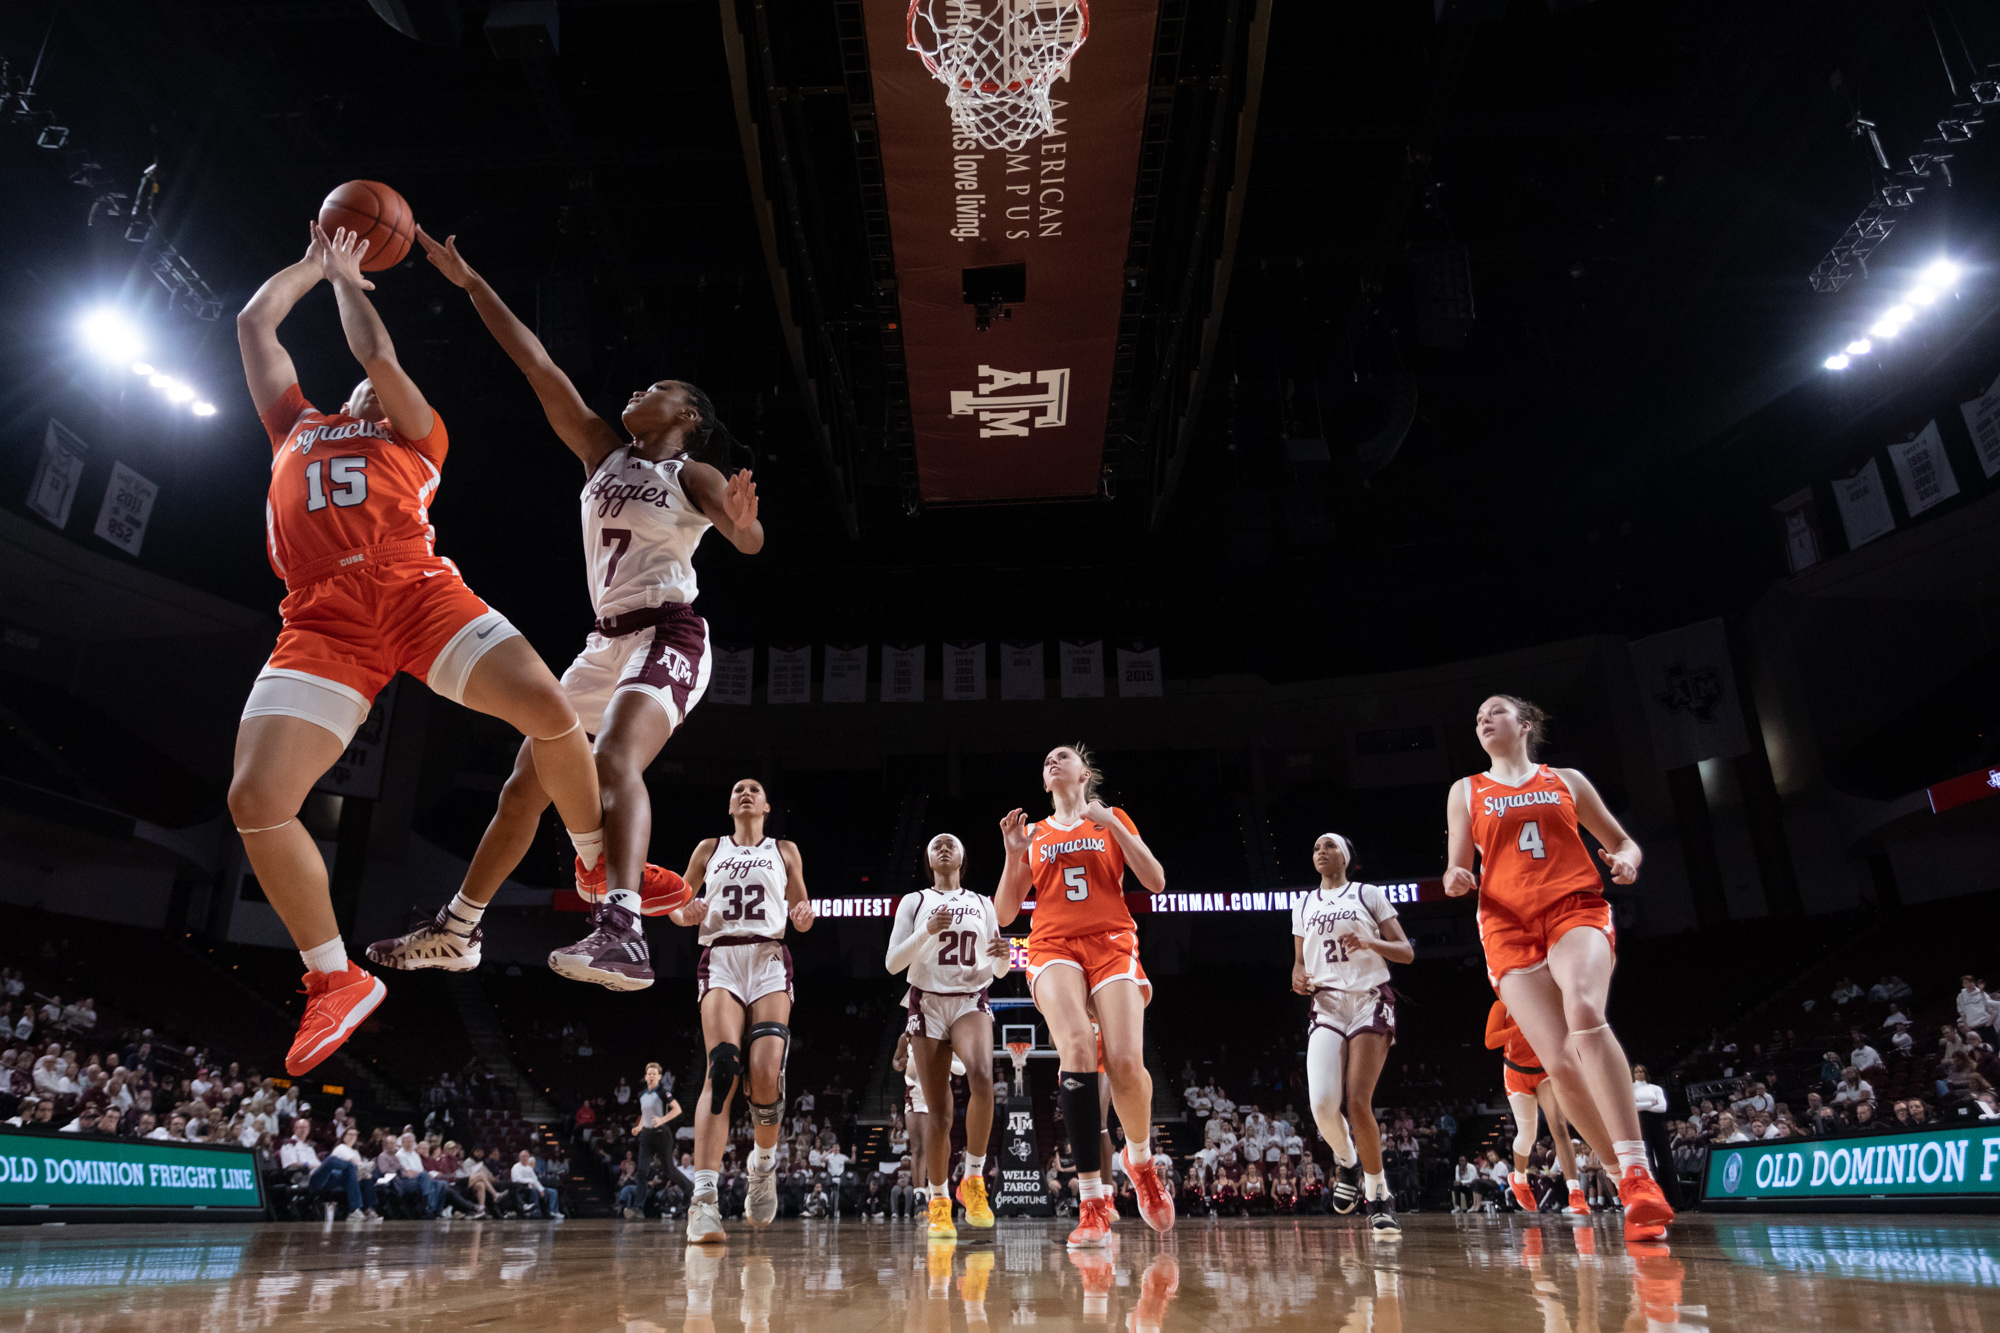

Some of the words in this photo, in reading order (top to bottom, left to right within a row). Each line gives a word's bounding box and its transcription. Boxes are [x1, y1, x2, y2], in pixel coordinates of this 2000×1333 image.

[953, 154, 985, 191] love
[1038, 99, 1069, 238] AMERICAN
[1006, 137, 1031, 240] MPUS
[950, 194, 986, 242] living.
[290, 421, 395, 455] Syracuse
[305, 456, 368, 513] 15
[585, 474, 671, 518] Aggies
[1914, 471, 1936, 490] 2007
[601, 528, 632, 587] 7
[1125, 670, 1154, 682] 2015
[1484, 791, 1561, 818] Syracuse
[1040, 838, 1106, 863] Syracuse
[1518, 821, 1546, 859] 4
[713, 857, 775, 879] Aggies
[1063, 866, 1089, 902] 5
[722, 884, 766, 921] 32
[1306, 908, 1360, 935] Aggies
[938, 930, 978, 967] 20
[1009, 949, 1029, 968] 26
[0, 1156, 38, 1184] OLD
[44, 1158, 145, 1187] DOMINION
[149, 1164, 217, 1189] FREIGHT
[220, 1168, 254, 1191] LINE
[1002, 1170, 1040, 1180] WELLS
[1755, 1152, 1803, 1189] OLD
[1810, 1140, 1969, 1187] DOMINION
[1003, 1182, 1041, 1192] FARGO
